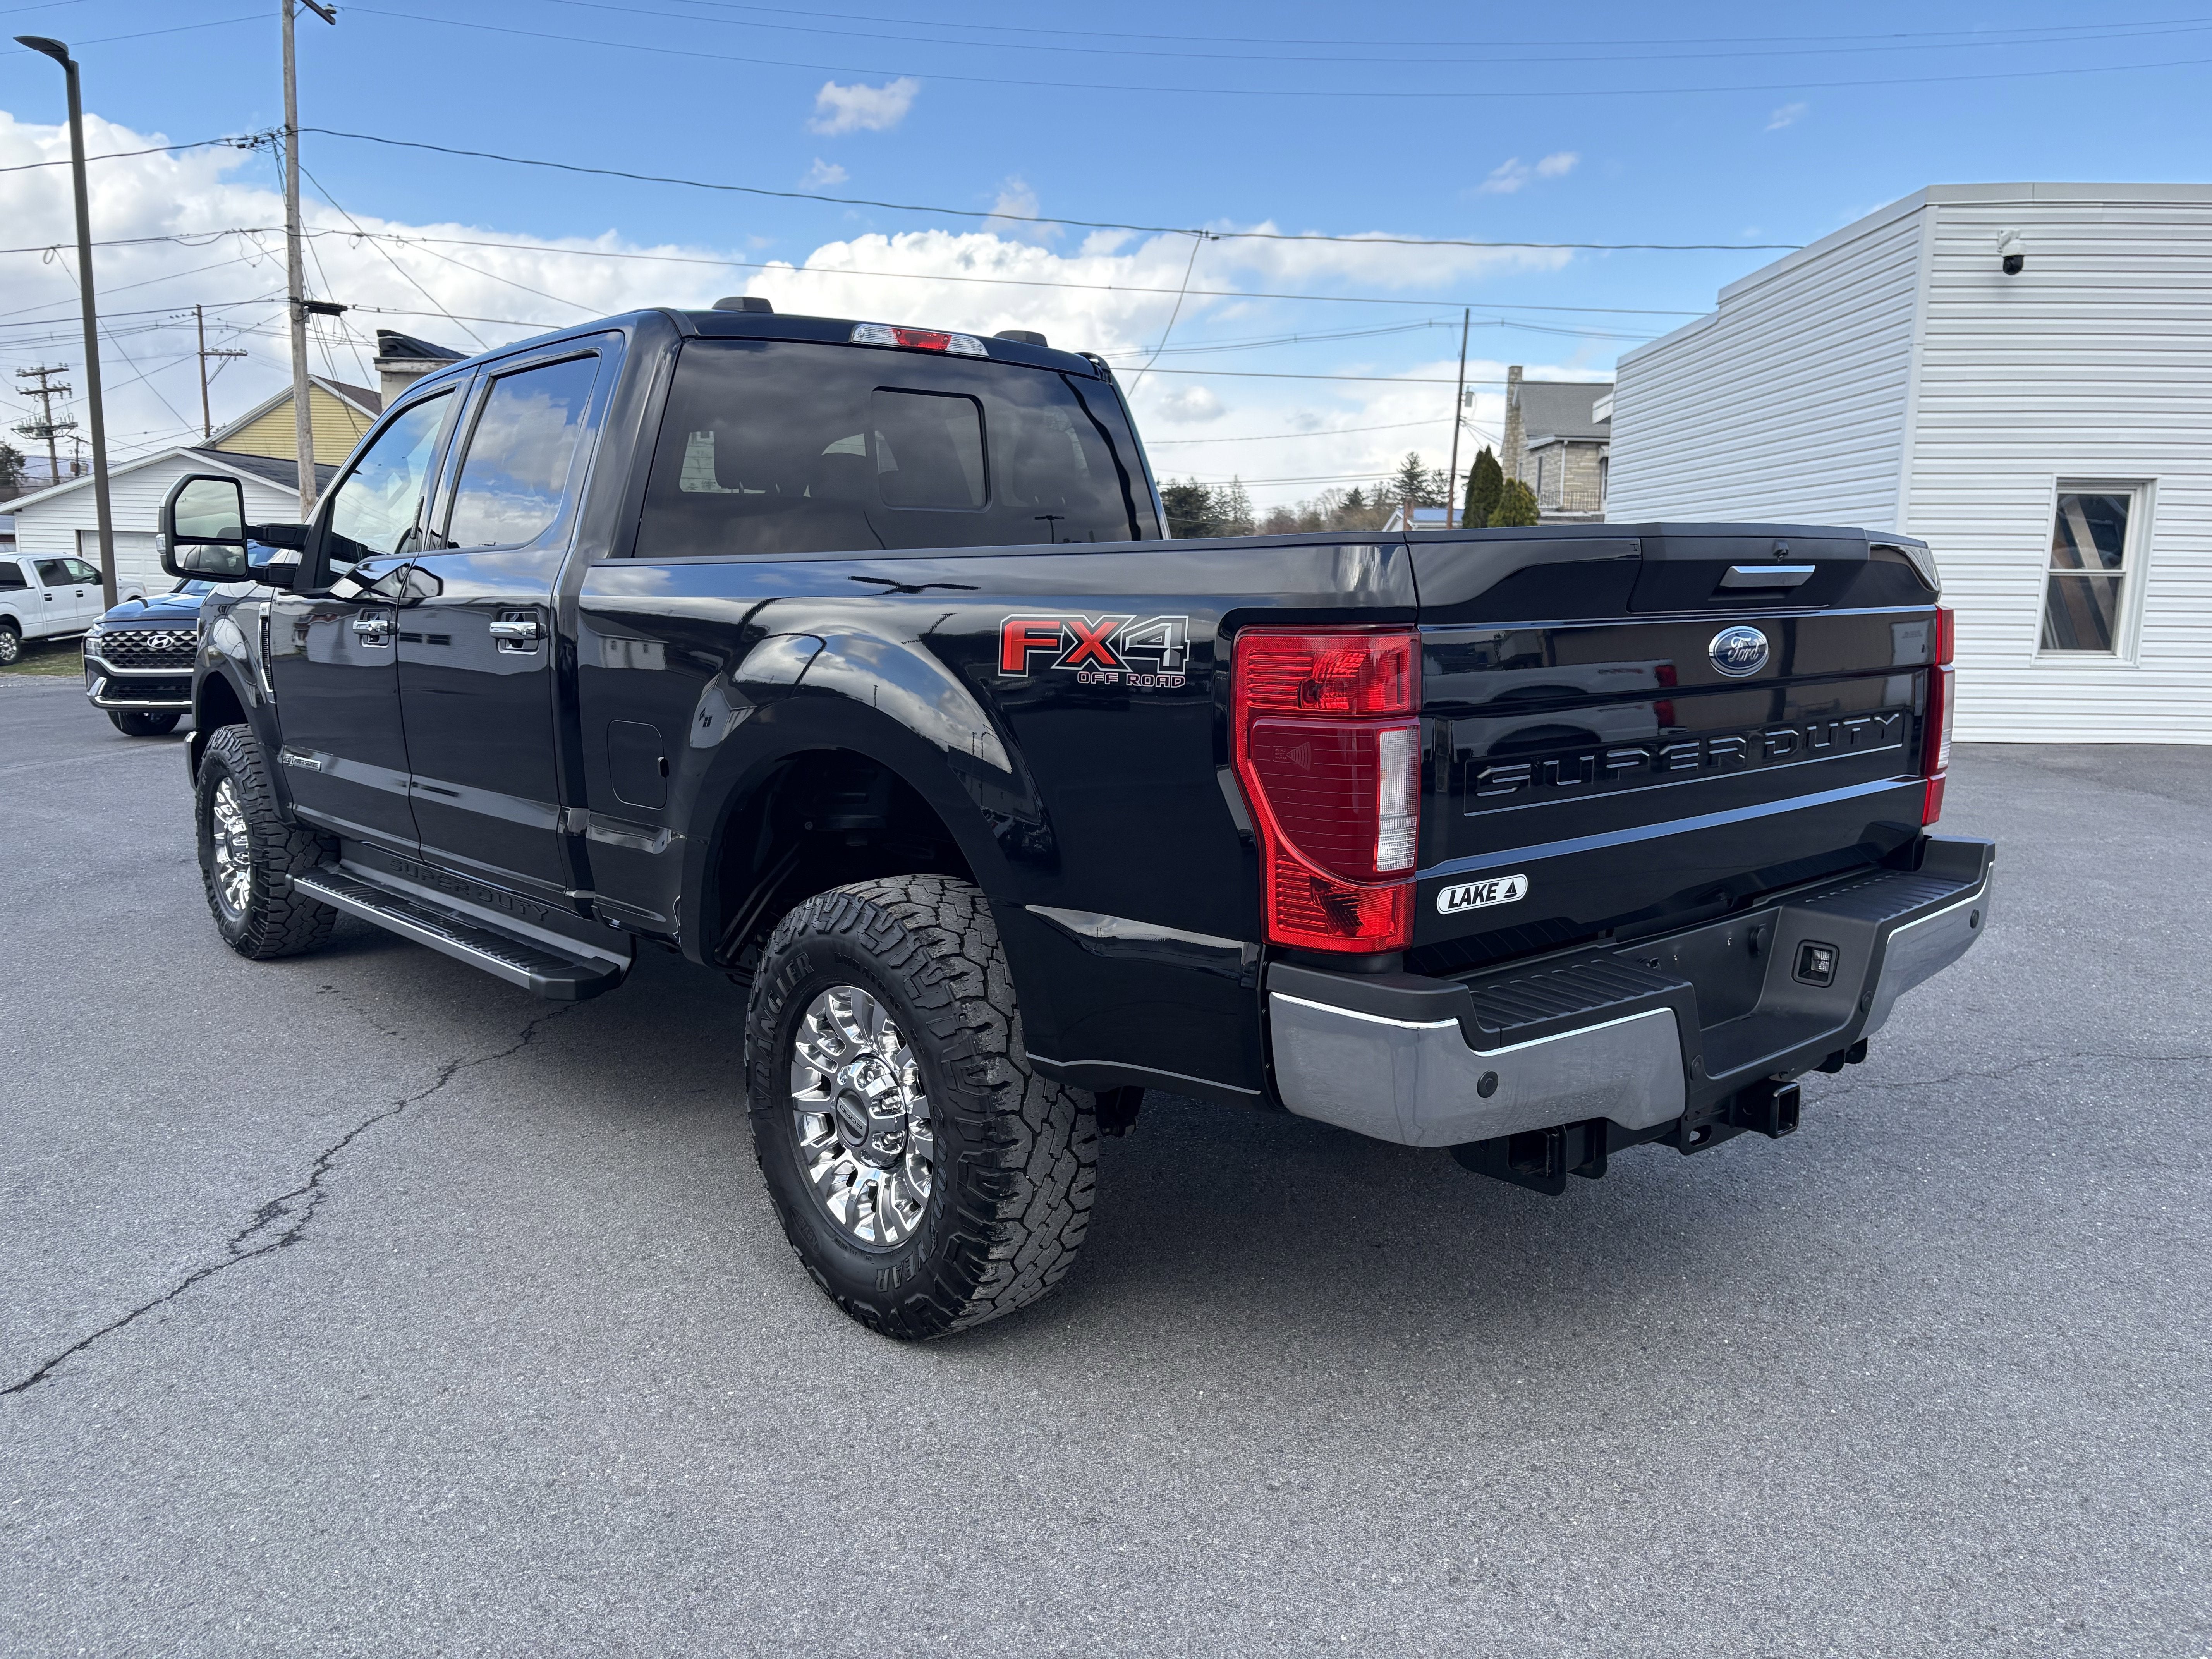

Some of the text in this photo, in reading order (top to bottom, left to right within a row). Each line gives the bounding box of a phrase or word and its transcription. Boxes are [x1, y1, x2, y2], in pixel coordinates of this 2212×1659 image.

[998, 614, 1190, 678] FX4
[1727, 636, 1759, 663] Ford
[1077, 672, 1186, 688] OFF ROAD
[1476, 711, 1900, 798] SUPER DUTY
[390, 857, 549, 921] SUPER DUTY
[1448, 882, 1499, 909] LAKE
[752, 951, 815, 1120] WRANGLER
[840, 1105, 863, 1130] FORD
